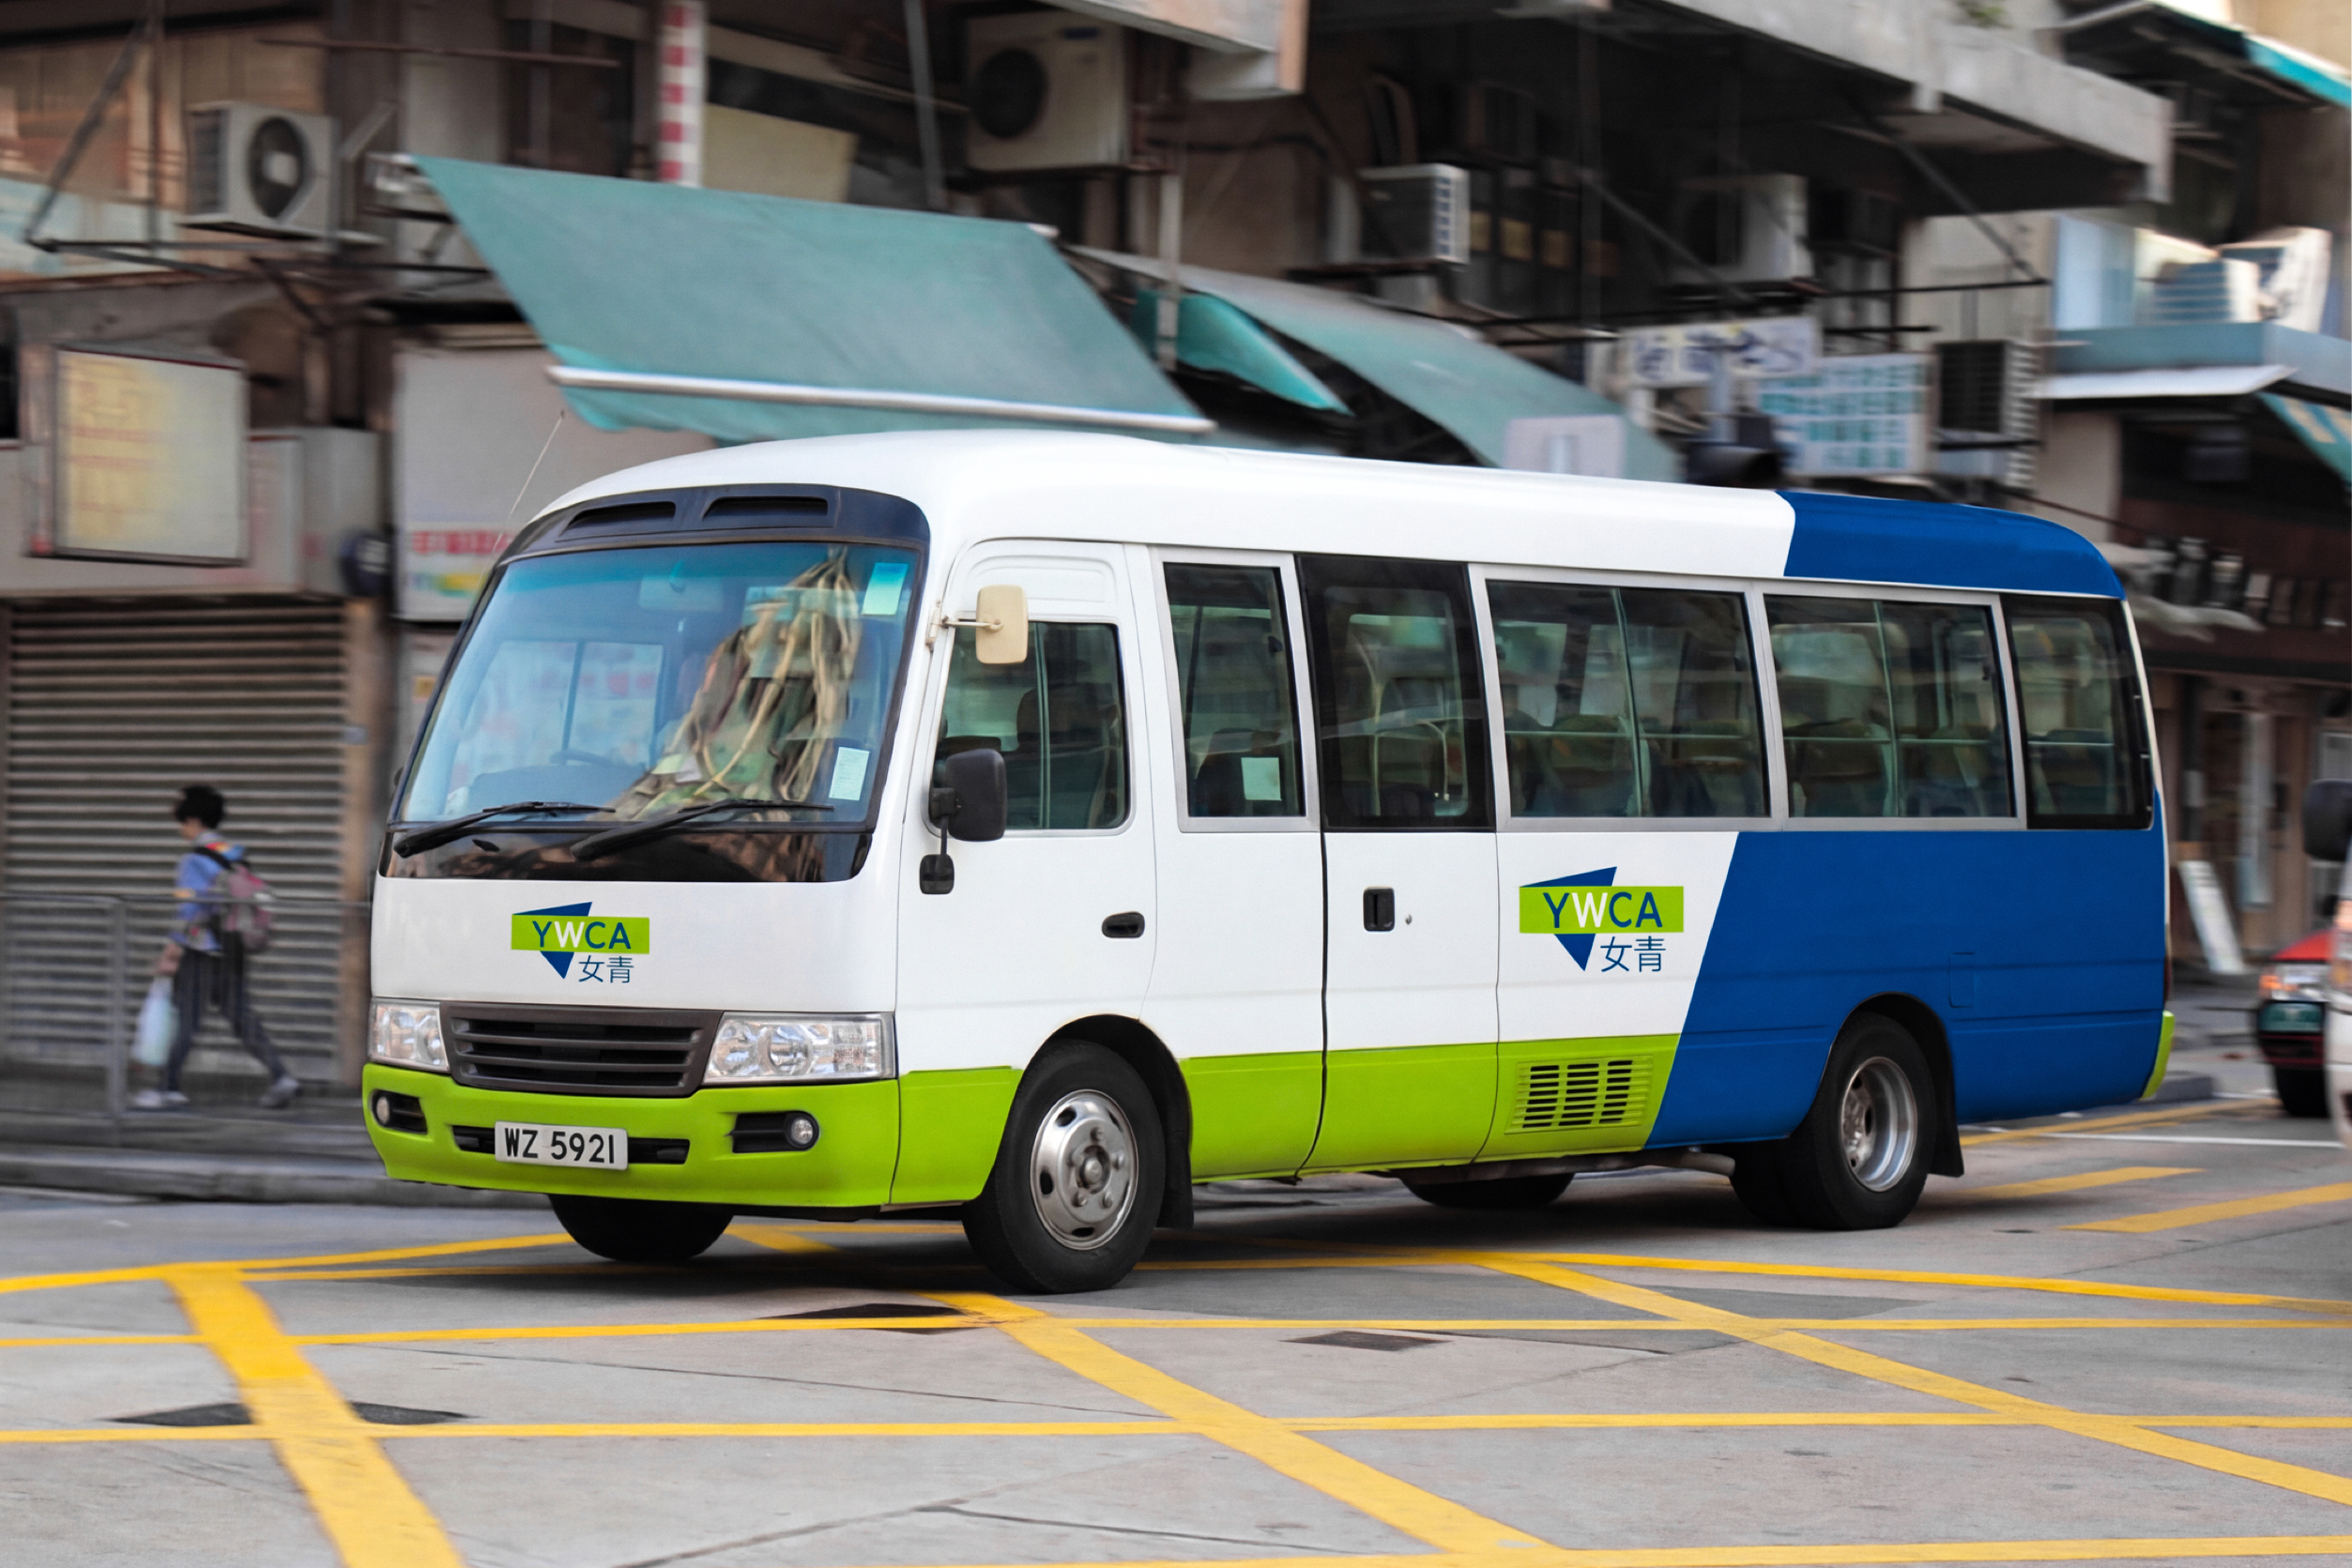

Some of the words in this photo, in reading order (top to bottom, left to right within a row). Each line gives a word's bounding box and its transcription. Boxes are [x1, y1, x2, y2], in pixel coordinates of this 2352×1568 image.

[1542, 891, 1663, 929] YWCA
[531, 920, 632, 950] YWCA
[1599, 935, 1667, 973] 女青
[577, 953, 634, 984] 女青
[504, 1127, 539, 1159] WZ
[550, 1130, 615, 1165] 5921
